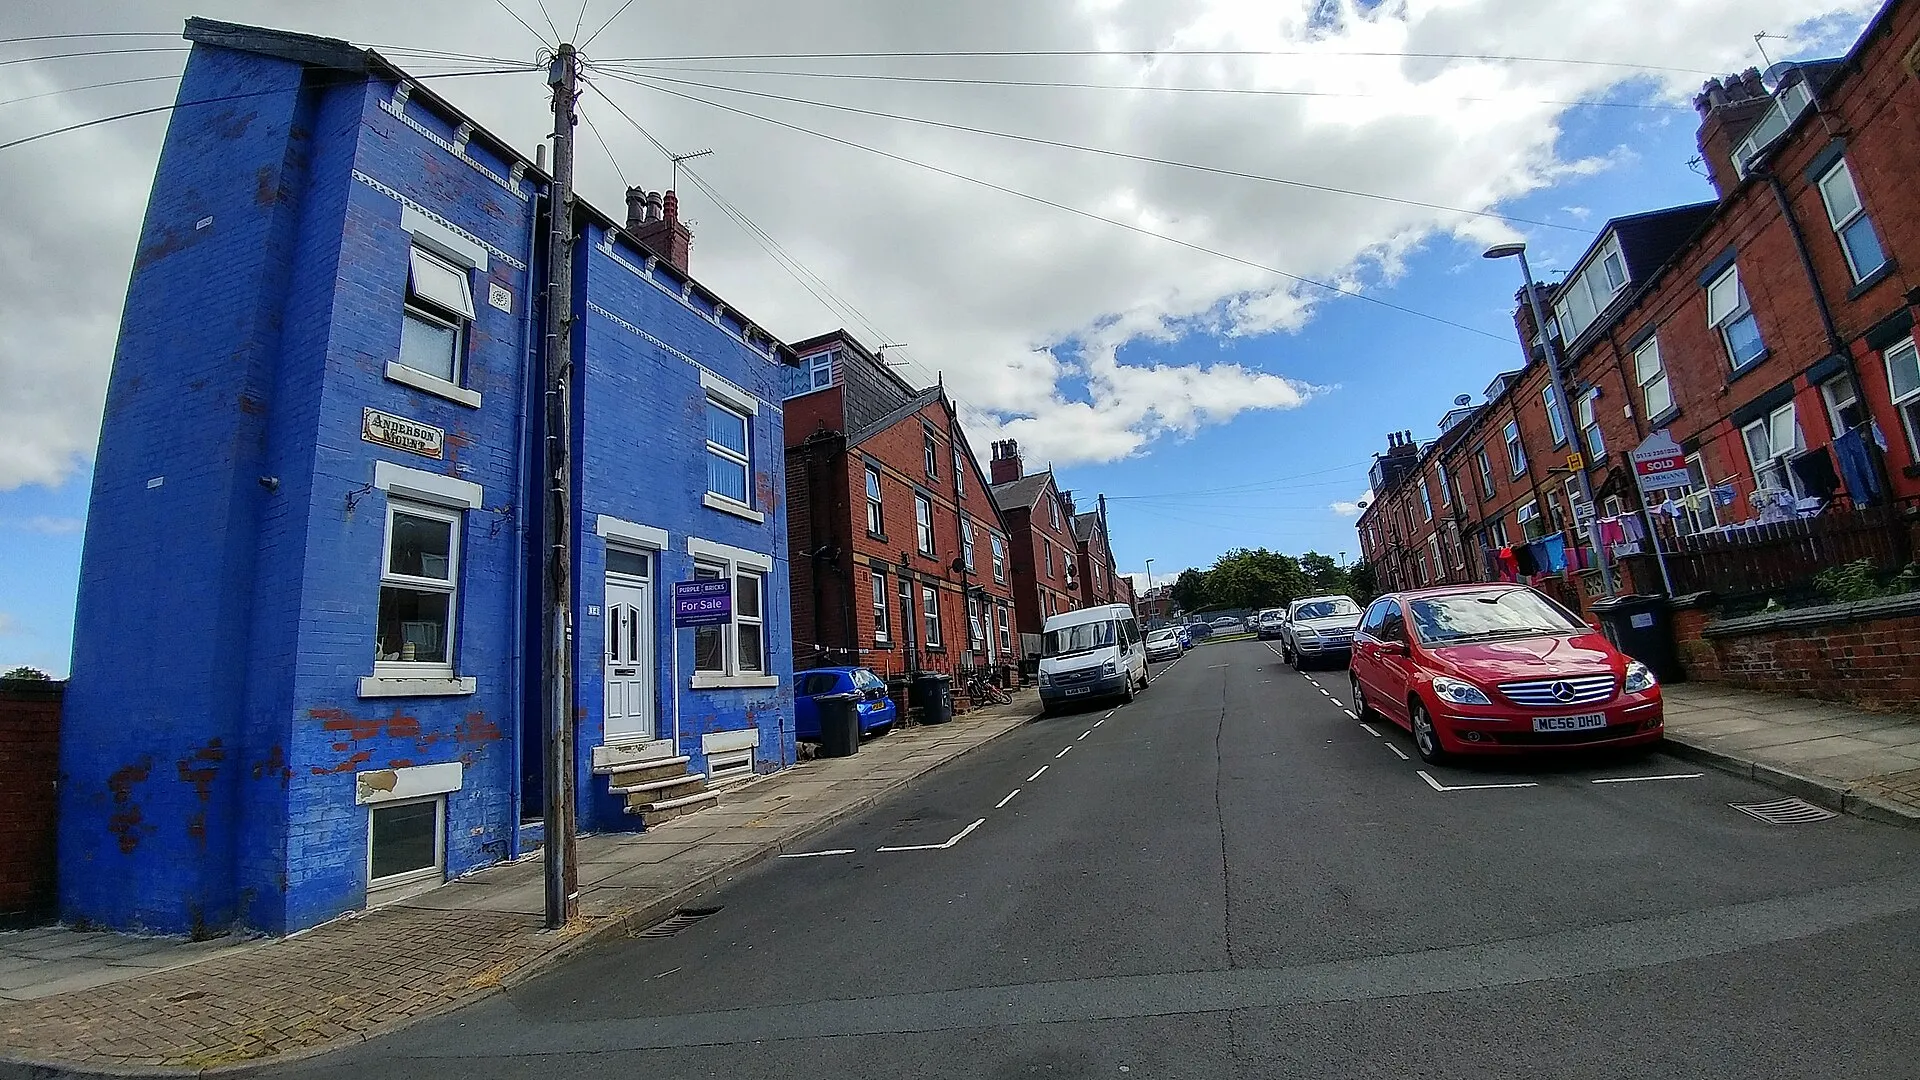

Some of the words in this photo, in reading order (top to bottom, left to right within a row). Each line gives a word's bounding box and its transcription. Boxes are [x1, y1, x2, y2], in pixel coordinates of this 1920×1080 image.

[371, 415, 435, 442] ANDERSON
[383, 429, 426, 450] MOUNT
[1646, 459, 1675, 471] SOLD
[679, 585, 700, 593] PURPLE
[704, 583, 725, 591] BRICKS
[681, 602, 698, 611] For
[700, 598, 722, 610] Sale
[1539, 717, 1575, 730] MC56
[1578, 714, 1601, 728] DHD
